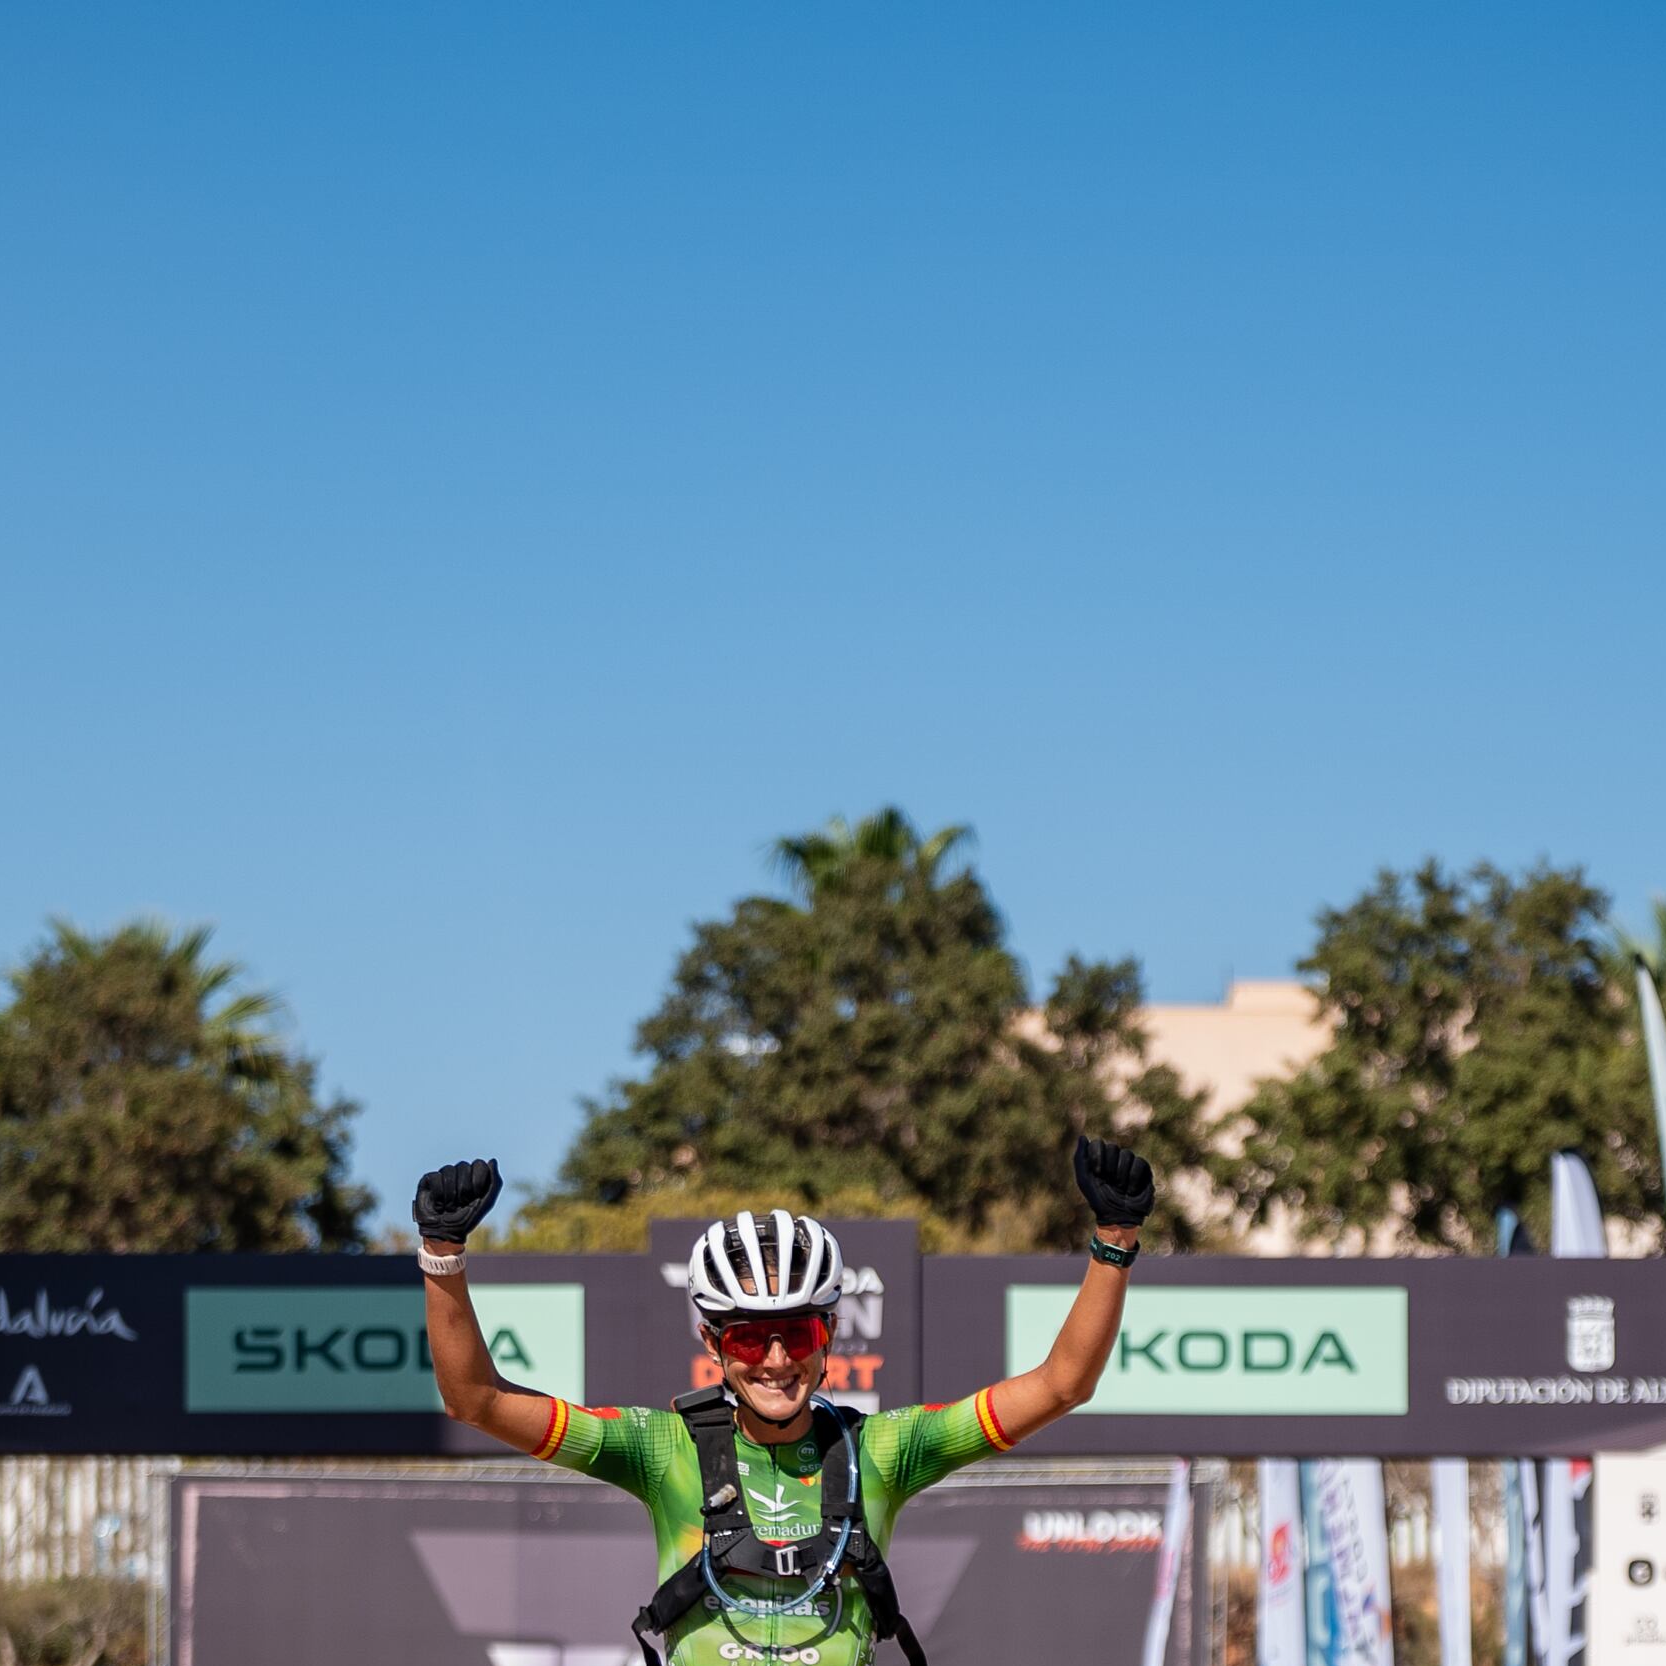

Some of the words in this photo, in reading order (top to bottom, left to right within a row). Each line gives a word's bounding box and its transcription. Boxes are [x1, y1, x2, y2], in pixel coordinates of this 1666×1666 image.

[1119, 1329, 1359, 1375] KODA
[1445, 1374, 1593, 1405] DIPUTACIÓN
[1595, 1376, 1631, 1404] DE
[1023, 1510, 1163, 1544] UNLOCK
